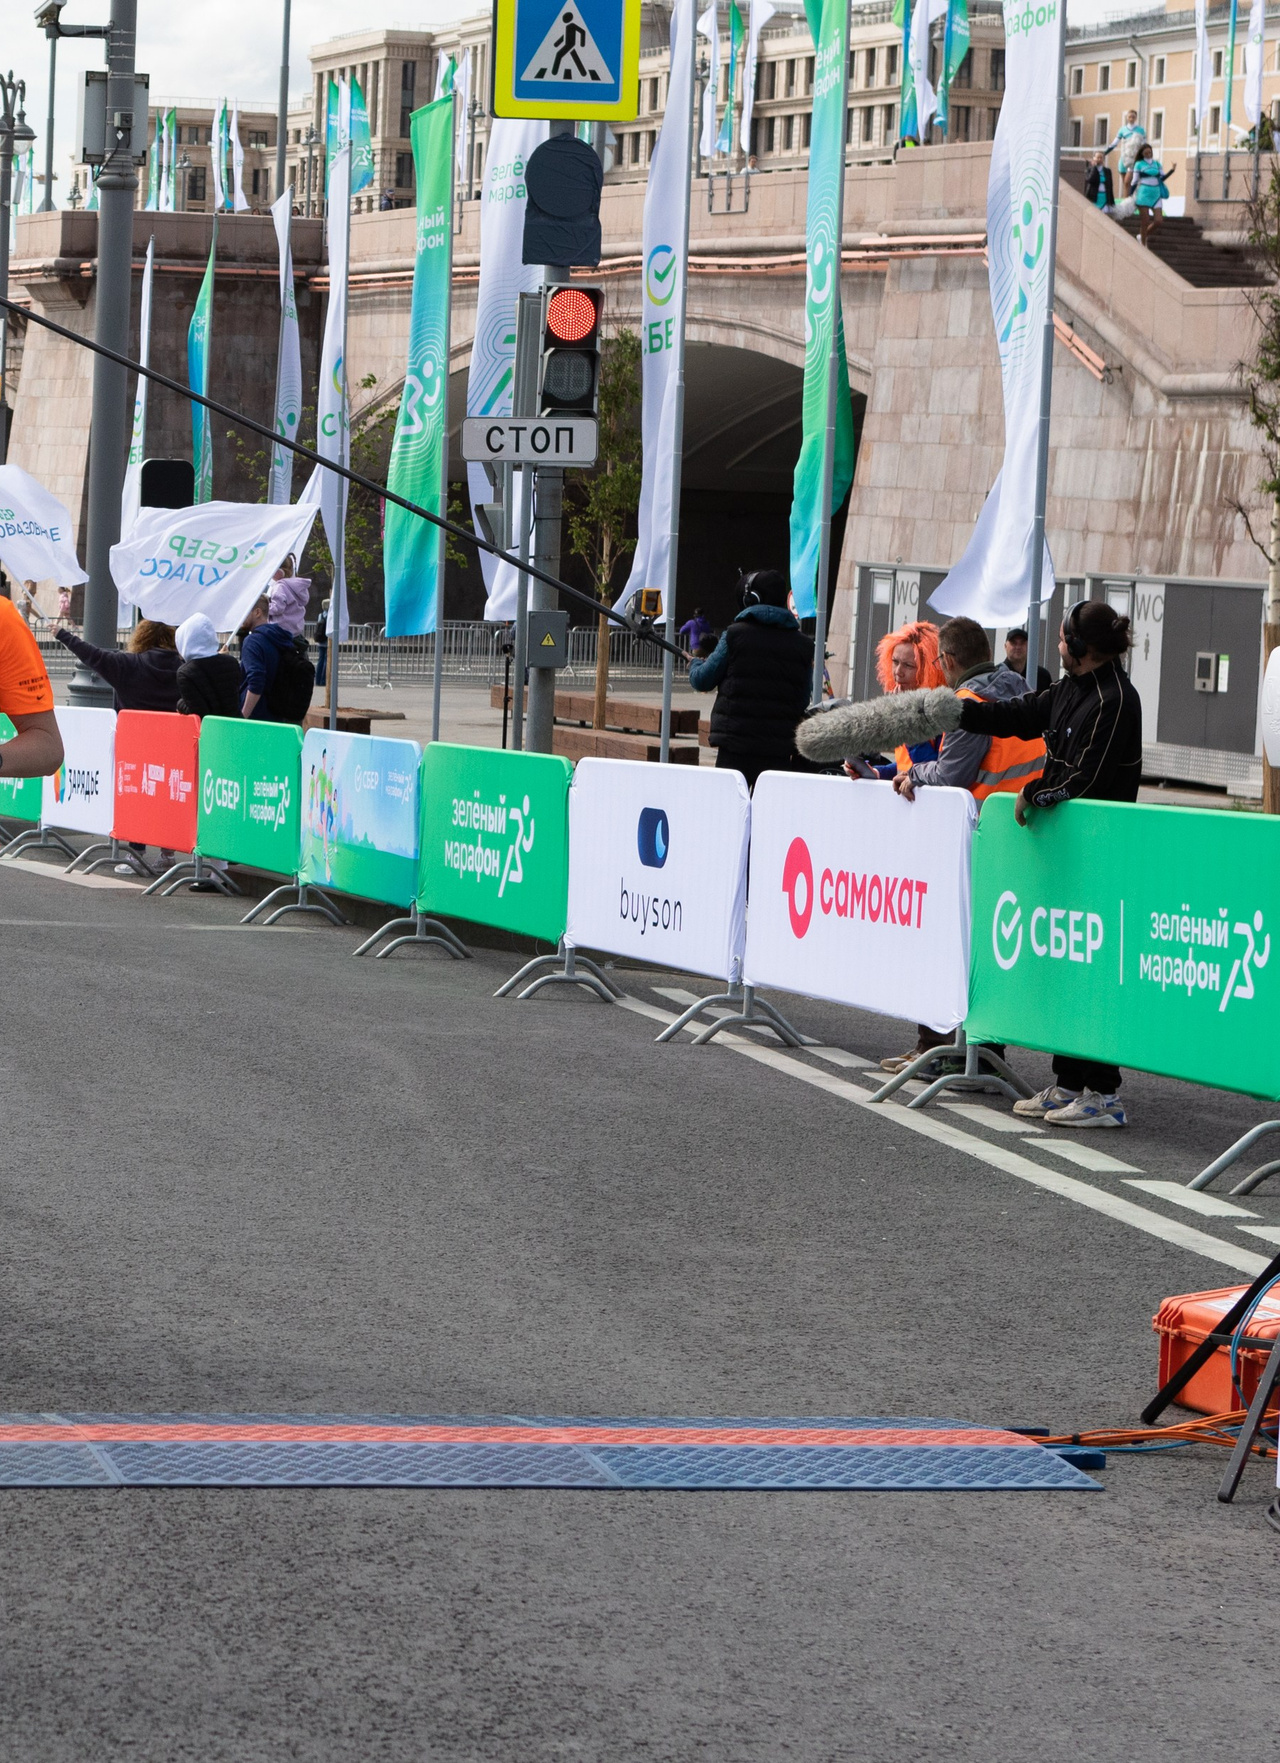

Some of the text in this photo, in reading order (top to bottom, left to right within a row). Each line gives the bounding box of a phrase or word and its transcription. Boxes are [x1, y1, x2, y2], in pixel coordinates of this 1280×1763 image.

[1007, 0, 1056, 40] рафон
[491, 154, 524, 182] зелё
[489, 183, 526, 204] мара
[644, 315, 676, 356] БЕ
[486, 425, 574, 454] СТОП
[896, 580, 920, 607] WC
[1135, 593, 1165, 622] WC
[216, 777, 240, 810] СБЕР
[253, 775, 279, 798] зелёный
[249, 798, 276, 826] марафон
[452, 790, 507, 835] зелёный
[444, 833, 500, 883] марафон
[619, 876, 683, 936] buyson
[820, 867, 928, 930] самокат
[1030, 906, 1104, 964] СБЕР
[1150, 903, 1229, 949] зелёный
[1139, 946, 1221, 997] марафон
